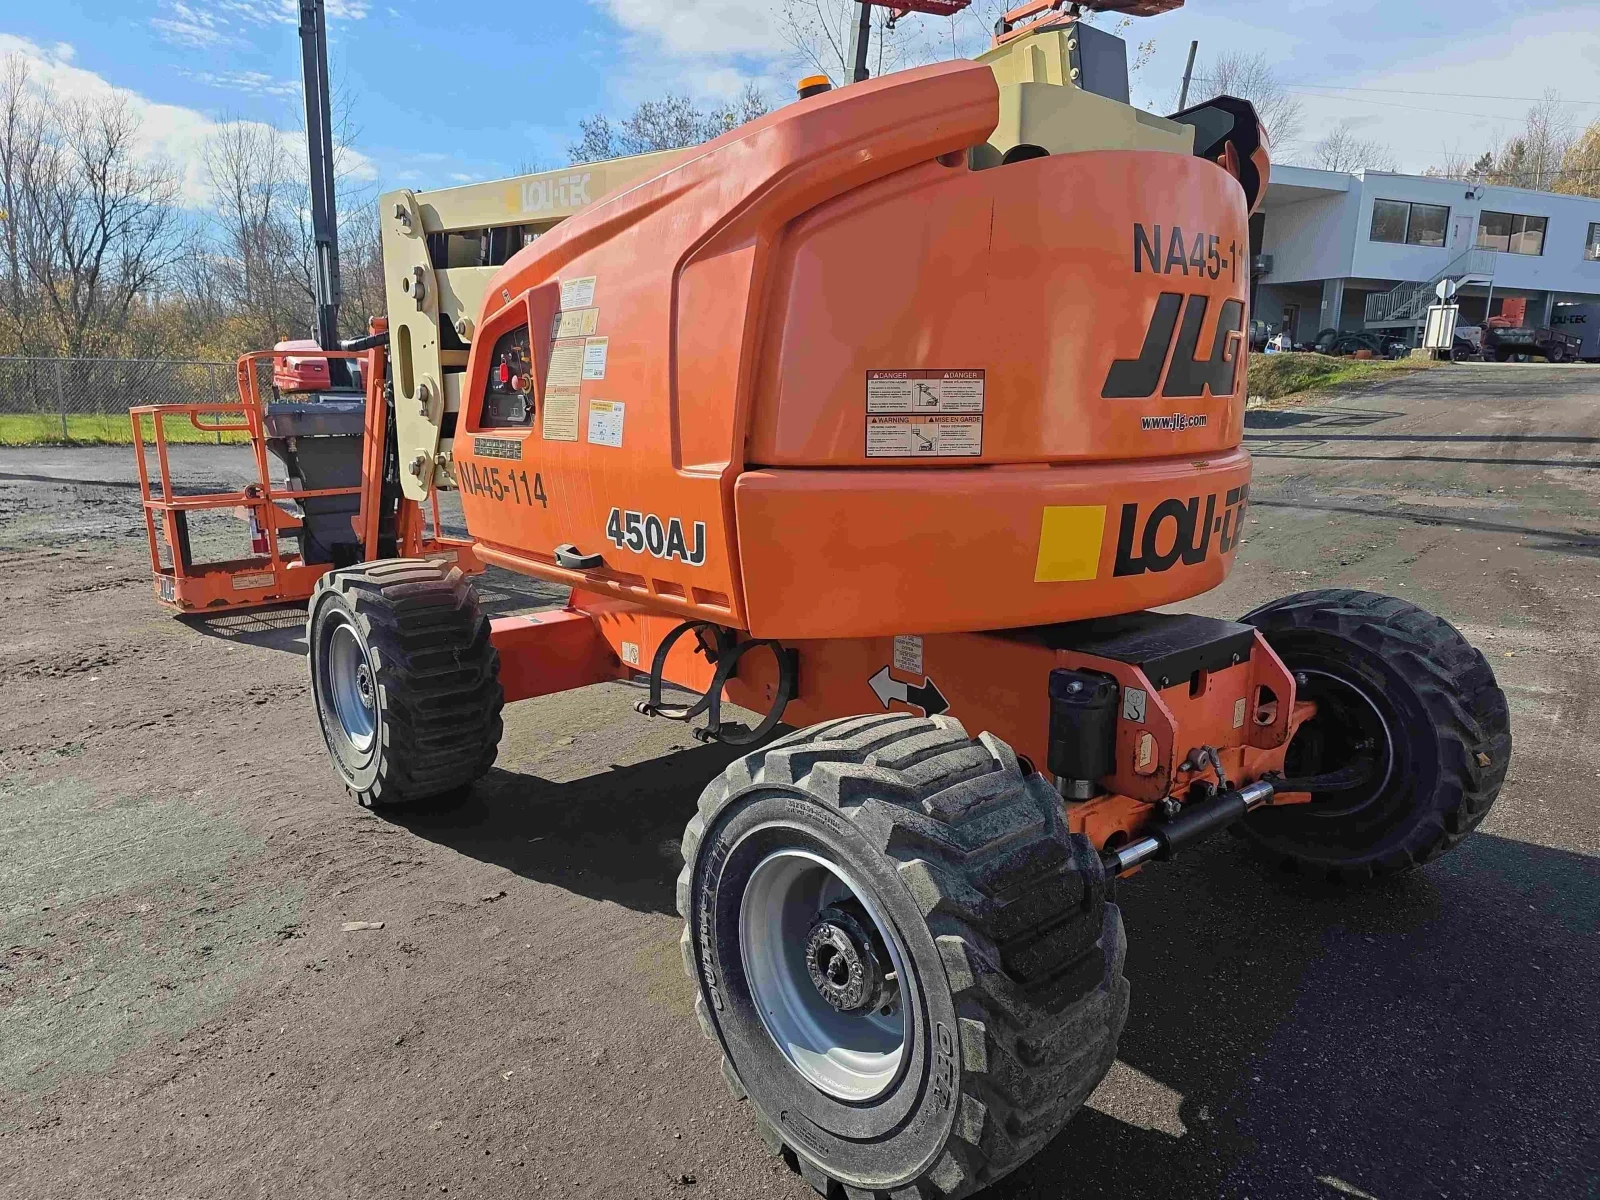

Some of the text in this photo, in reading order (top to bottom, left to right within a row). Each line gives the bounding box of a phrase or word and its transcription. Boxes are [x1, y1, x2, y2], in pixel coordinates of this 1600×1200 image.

[1101, 293, 1246, 398] JLG
[1141, 413, 1207, 432] www.jlg.com
[458, 461, 547, 508] NA45-114
[606, 507, 706, 566] 450AJ
